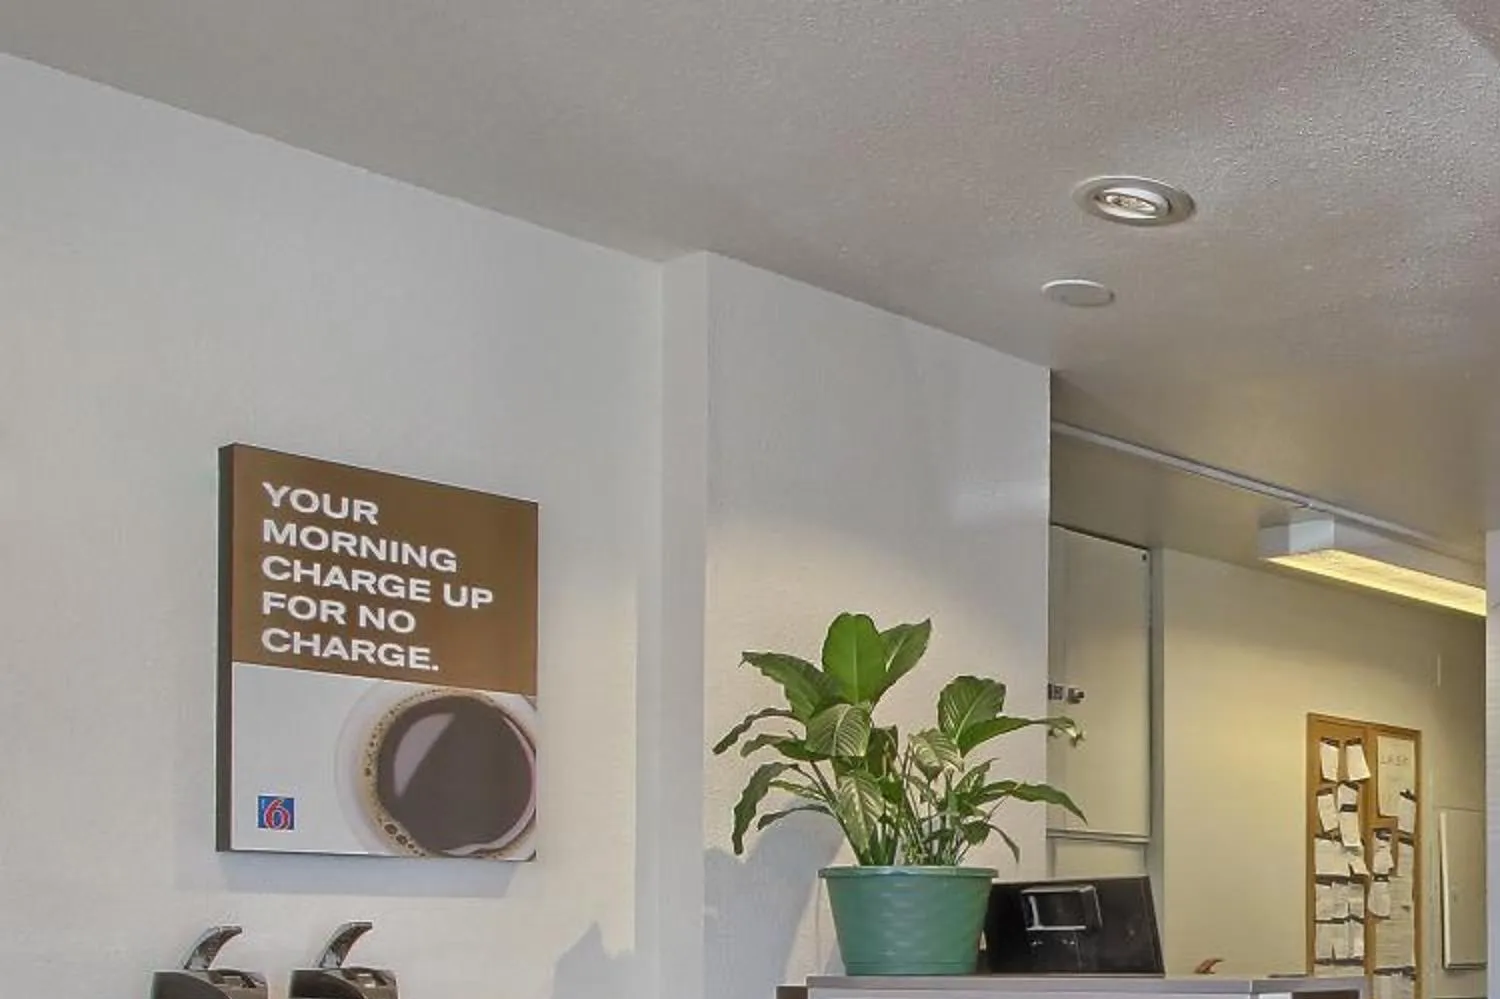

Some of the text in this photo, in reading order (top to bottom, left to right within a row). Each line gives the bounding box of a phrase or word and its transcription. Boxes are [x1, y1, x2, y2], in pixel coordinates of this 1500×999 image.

[262, 481, 379, 526] YOUR
[262, 518, 458, 573] MORNING
[261, 555, 493, 610] CHARGE UP
[262, 591, 416, 634] FOR NO
[261, 627, 440, 672] CHARGE.
